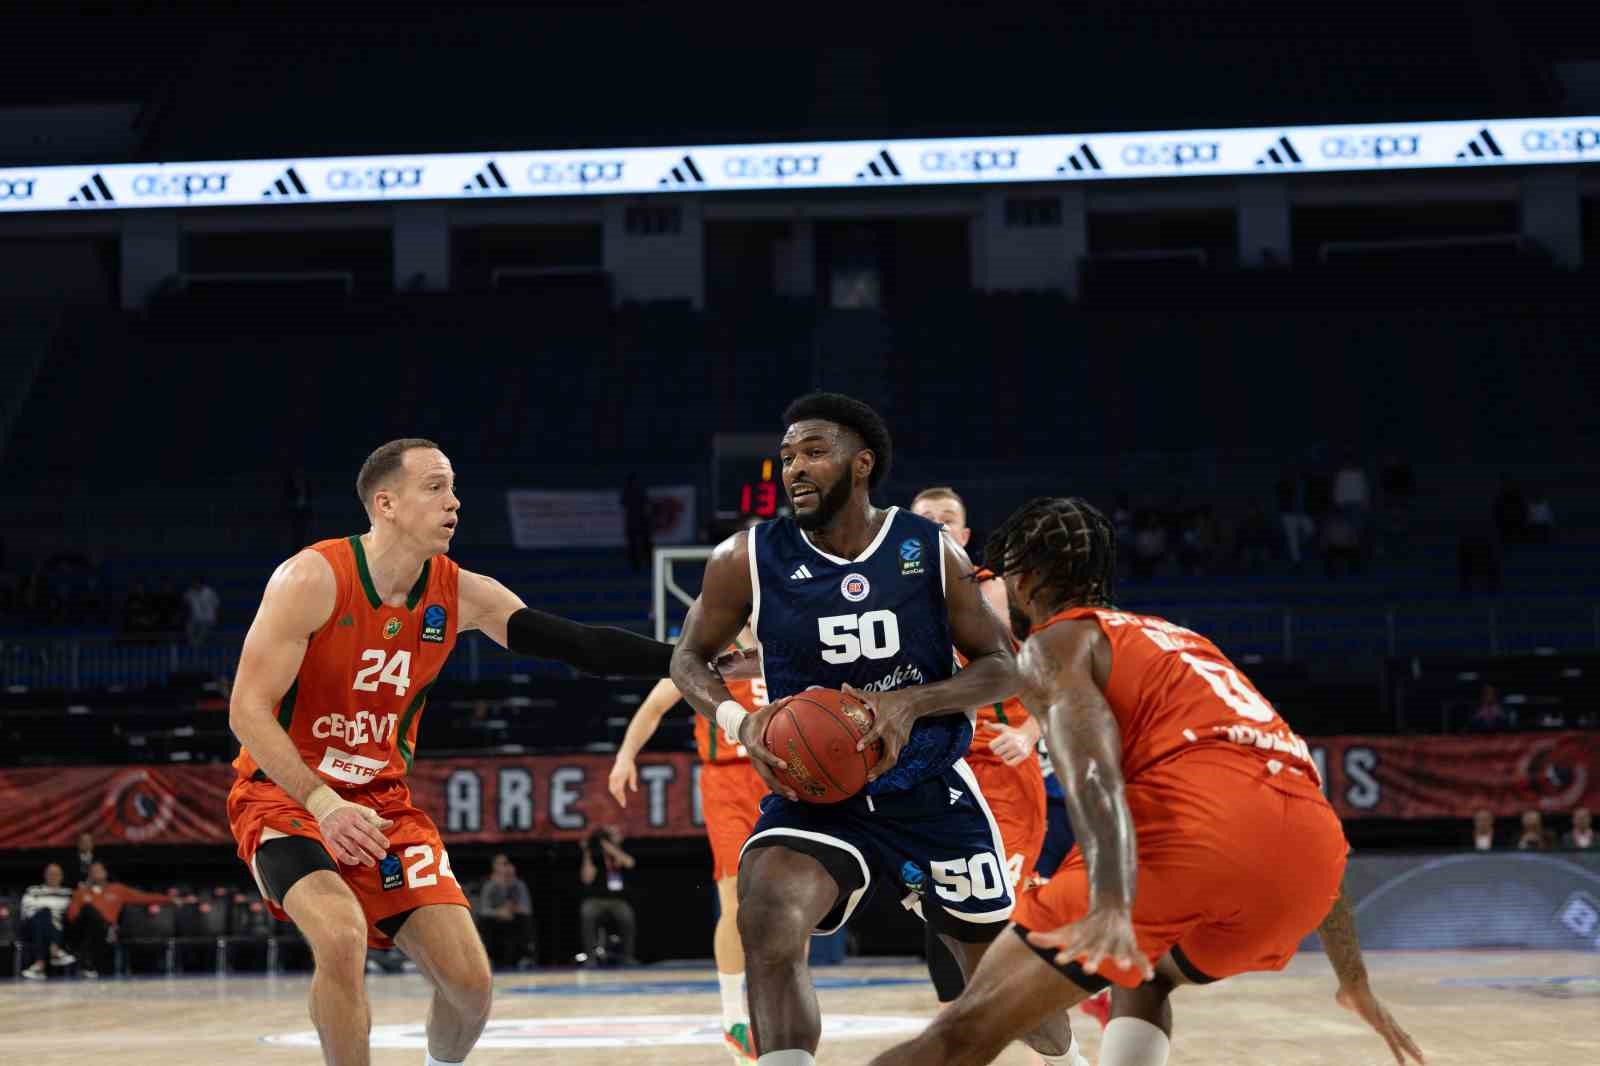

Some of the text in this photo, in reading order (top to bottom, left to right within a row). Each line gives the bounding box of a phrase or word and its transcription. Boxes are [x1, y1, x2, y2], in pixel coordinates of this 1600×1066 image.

[741, 482, 777, 517] 13
[818, 609, 901, 664] 50
[353, 649, 412, 696] 24
[447, 766, 585, 832] ARE
[930, 852, 1004, 902] 50
